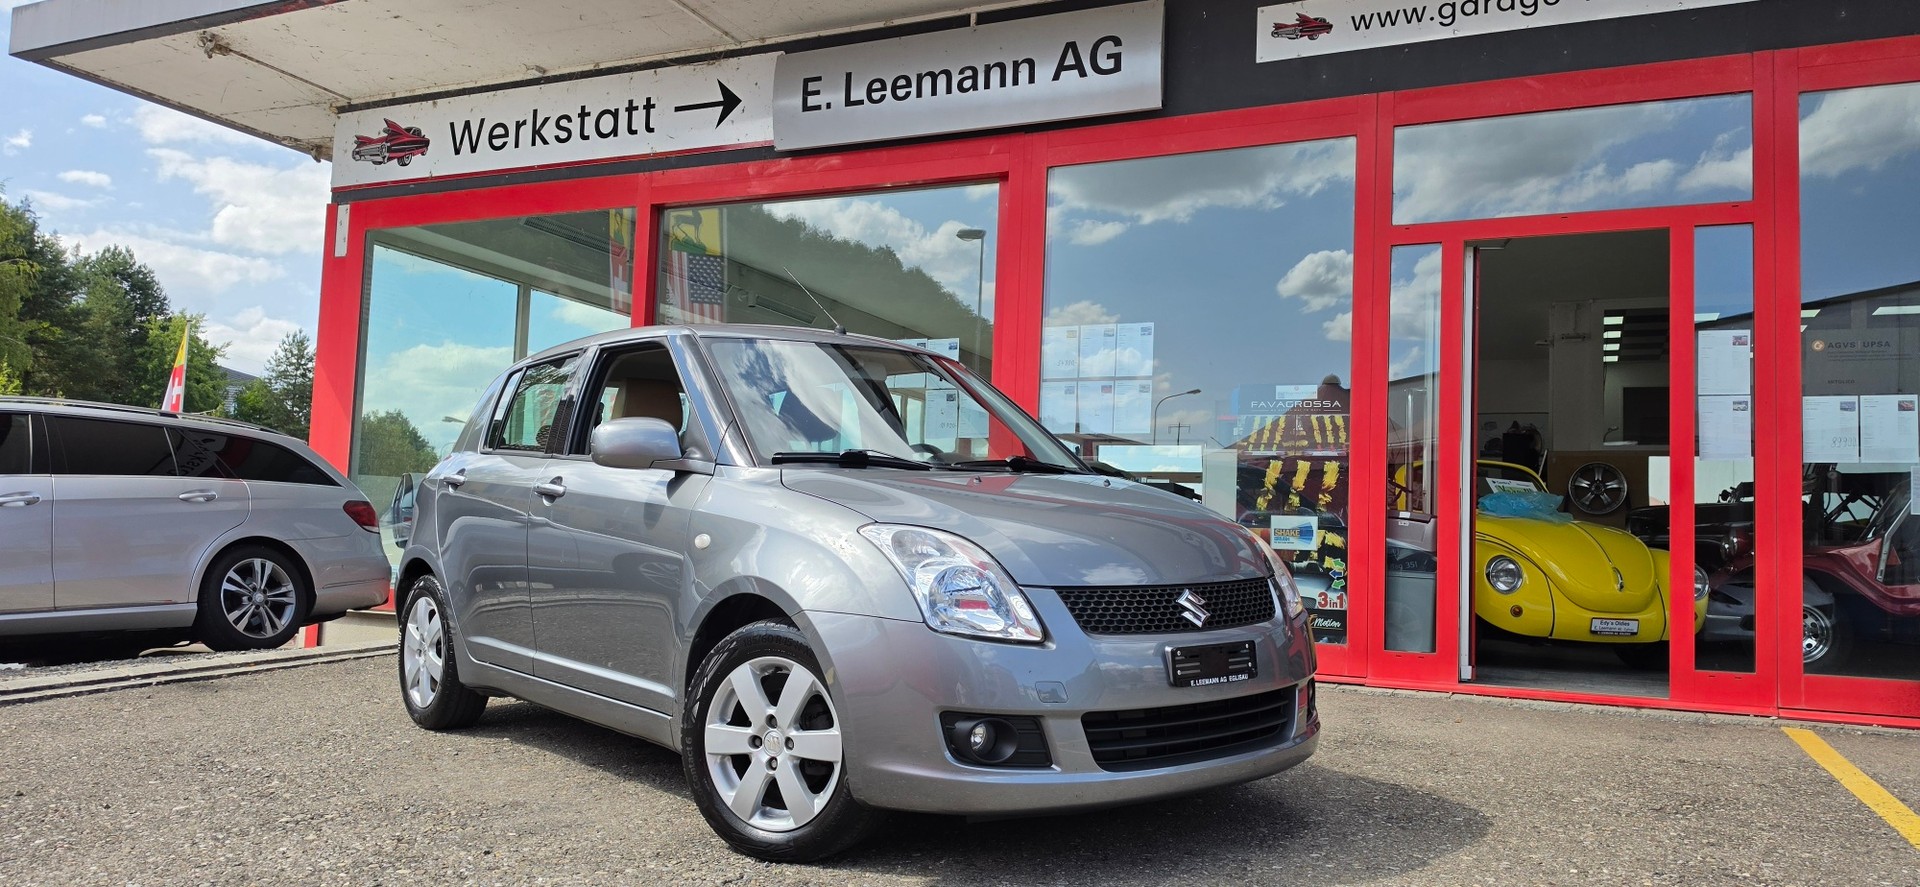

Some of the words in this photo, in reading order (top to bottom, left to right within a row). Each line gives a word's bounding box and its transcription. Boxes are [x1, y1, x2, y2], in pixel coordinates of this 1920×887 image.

[801, 76, 832, 113] E.
[844, 56, 1036, 108] Leemann
[1052, 34, 1123, 82] AG
[450, 96, 657, 156] Werkstatt
[1827, 341, 1856, 349] AGVS
[1862, 340, 1891, 348] UPSA
[1250, 400, 1342, 408] FAVAGROSSA
[1274, 529, 1300, 537] SHAKE
[1195, 677, 1219, 686] LEEMANN
[1228, 673, 1249, 682] EGLISAU
